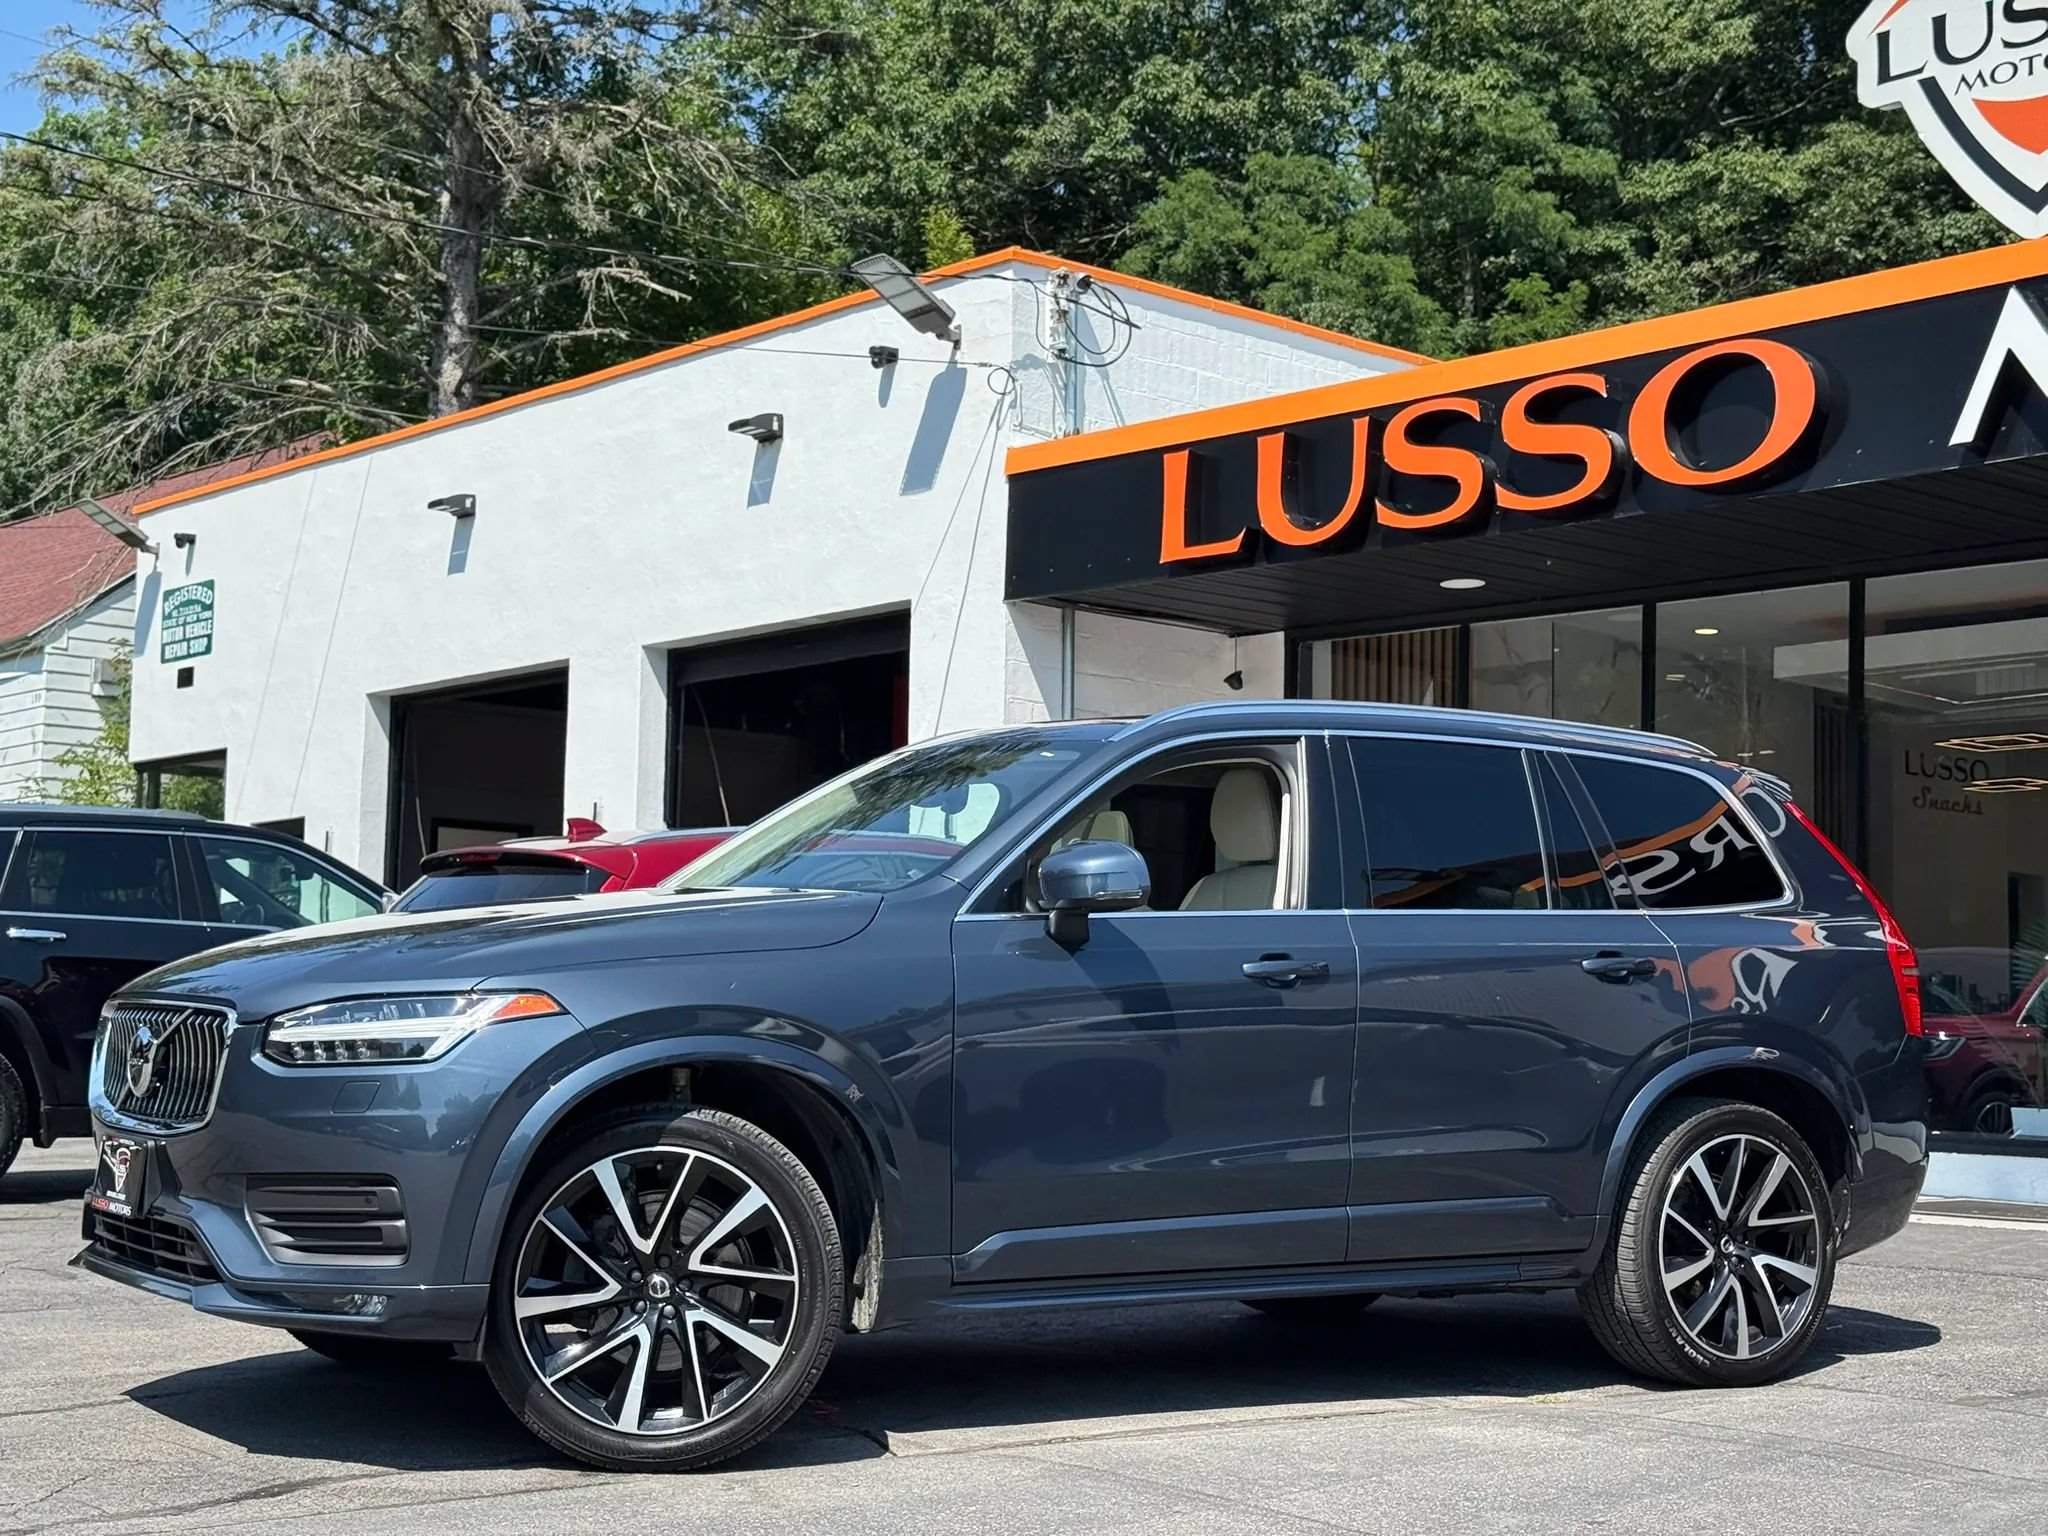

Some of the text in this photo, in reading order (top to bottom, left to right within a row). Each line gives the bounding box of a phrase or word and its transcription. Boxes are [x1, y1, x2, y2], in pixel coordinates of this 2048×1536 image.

[1954, 53, 2048, 96] MOT
[1159, 337, 1818, 564] LUSSO
[164, 584, 213, 616] REGISTERED
[162, 619, 213, 644] MOTOR VEHICLE
[164, 637, 208, 659] REPAIR SHOP
[1904, 750, 1990, 783] LUSSO
[1912, 786, 1984, 815] Snacks
[109, 1202, 132, 1216] MOTORS
